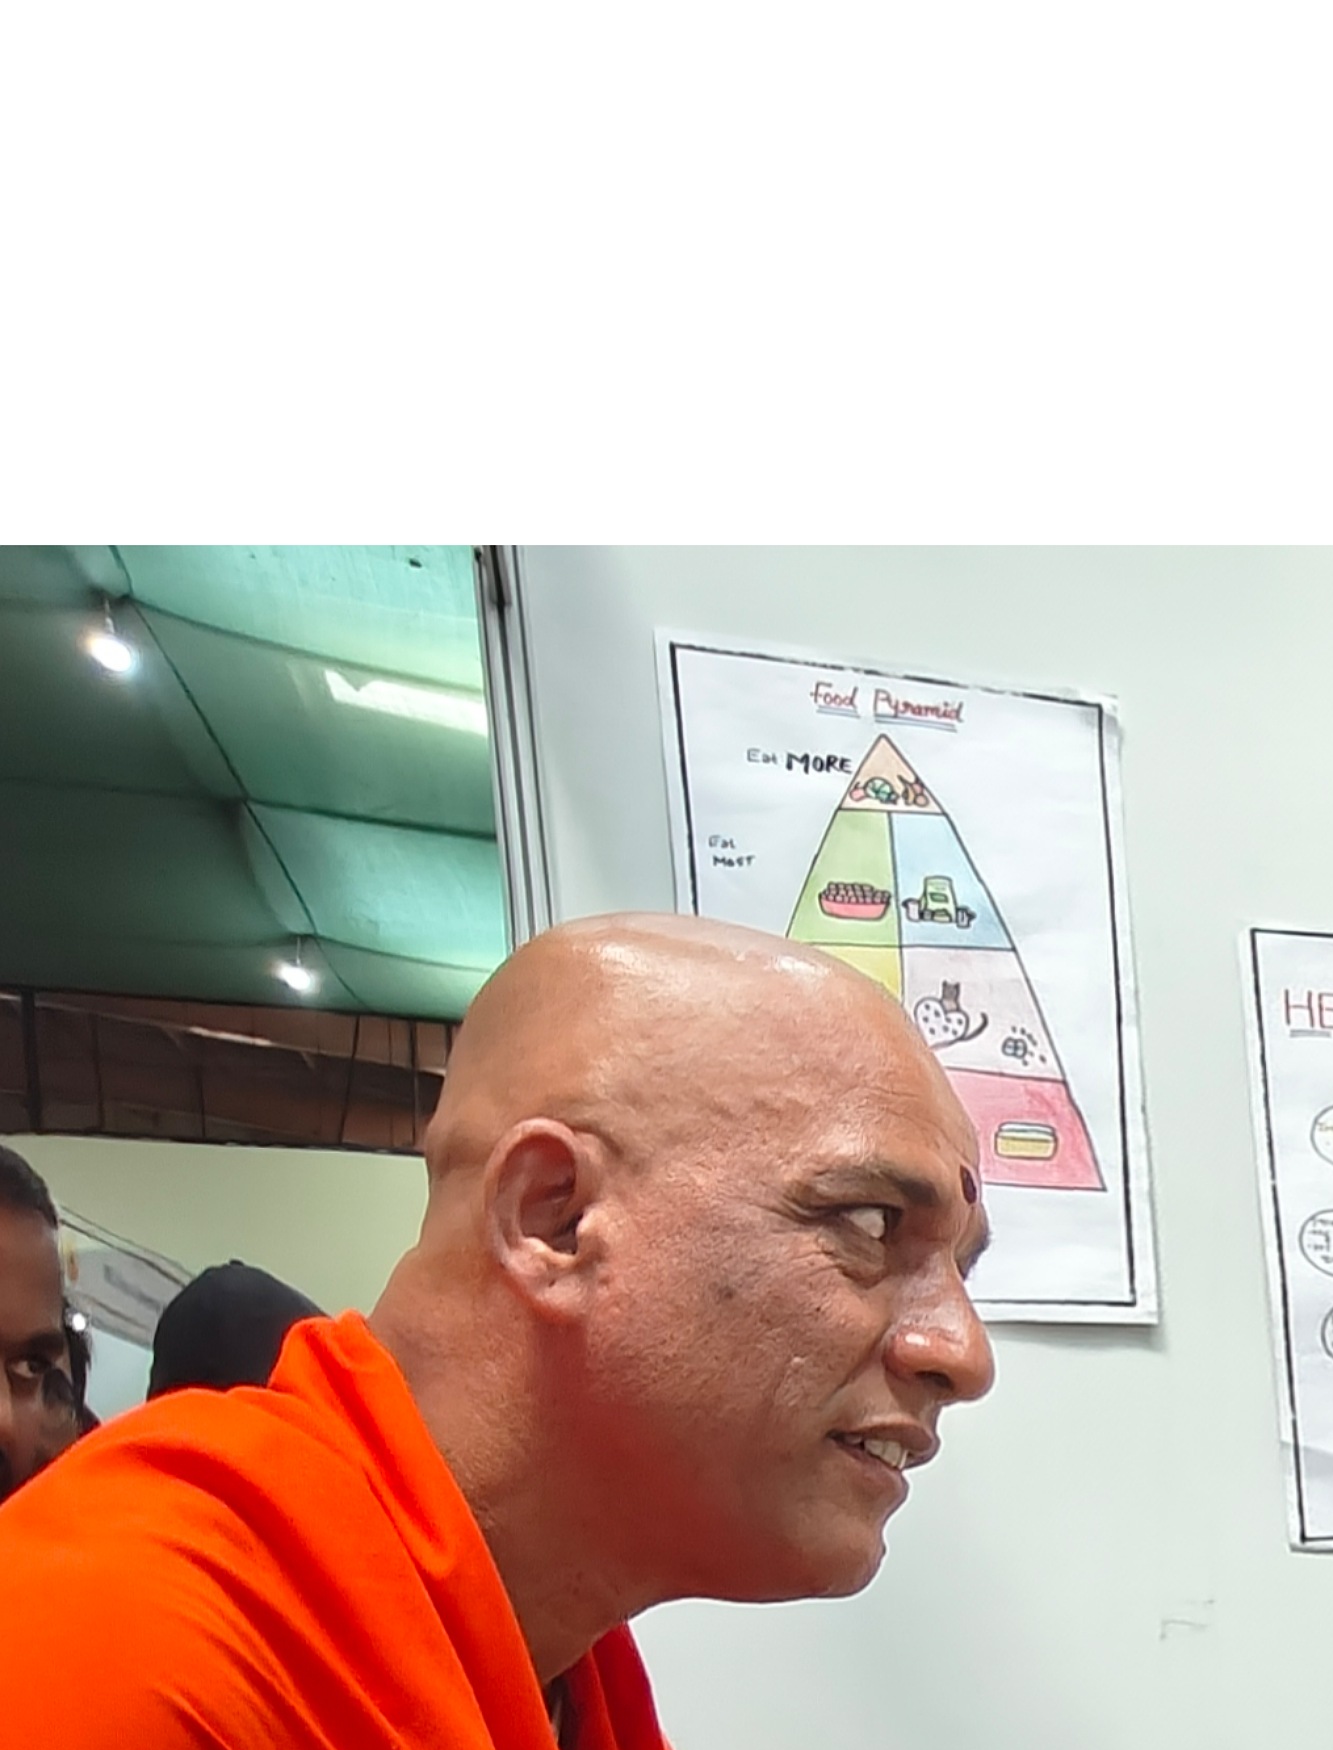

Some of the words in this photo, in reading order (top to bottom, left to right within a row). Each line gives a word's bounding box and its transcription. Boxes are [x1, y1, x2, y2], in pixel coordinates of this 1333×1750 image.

[810, 681, 859, 708] Food
[873, 688, 964, 722] Pyramid
[747, 748, 778, 764] Eat
[786, 752, 853, 774] MORE
[709, 835, 736, 849] Eat
[713, 856, 755, 867] MOST
